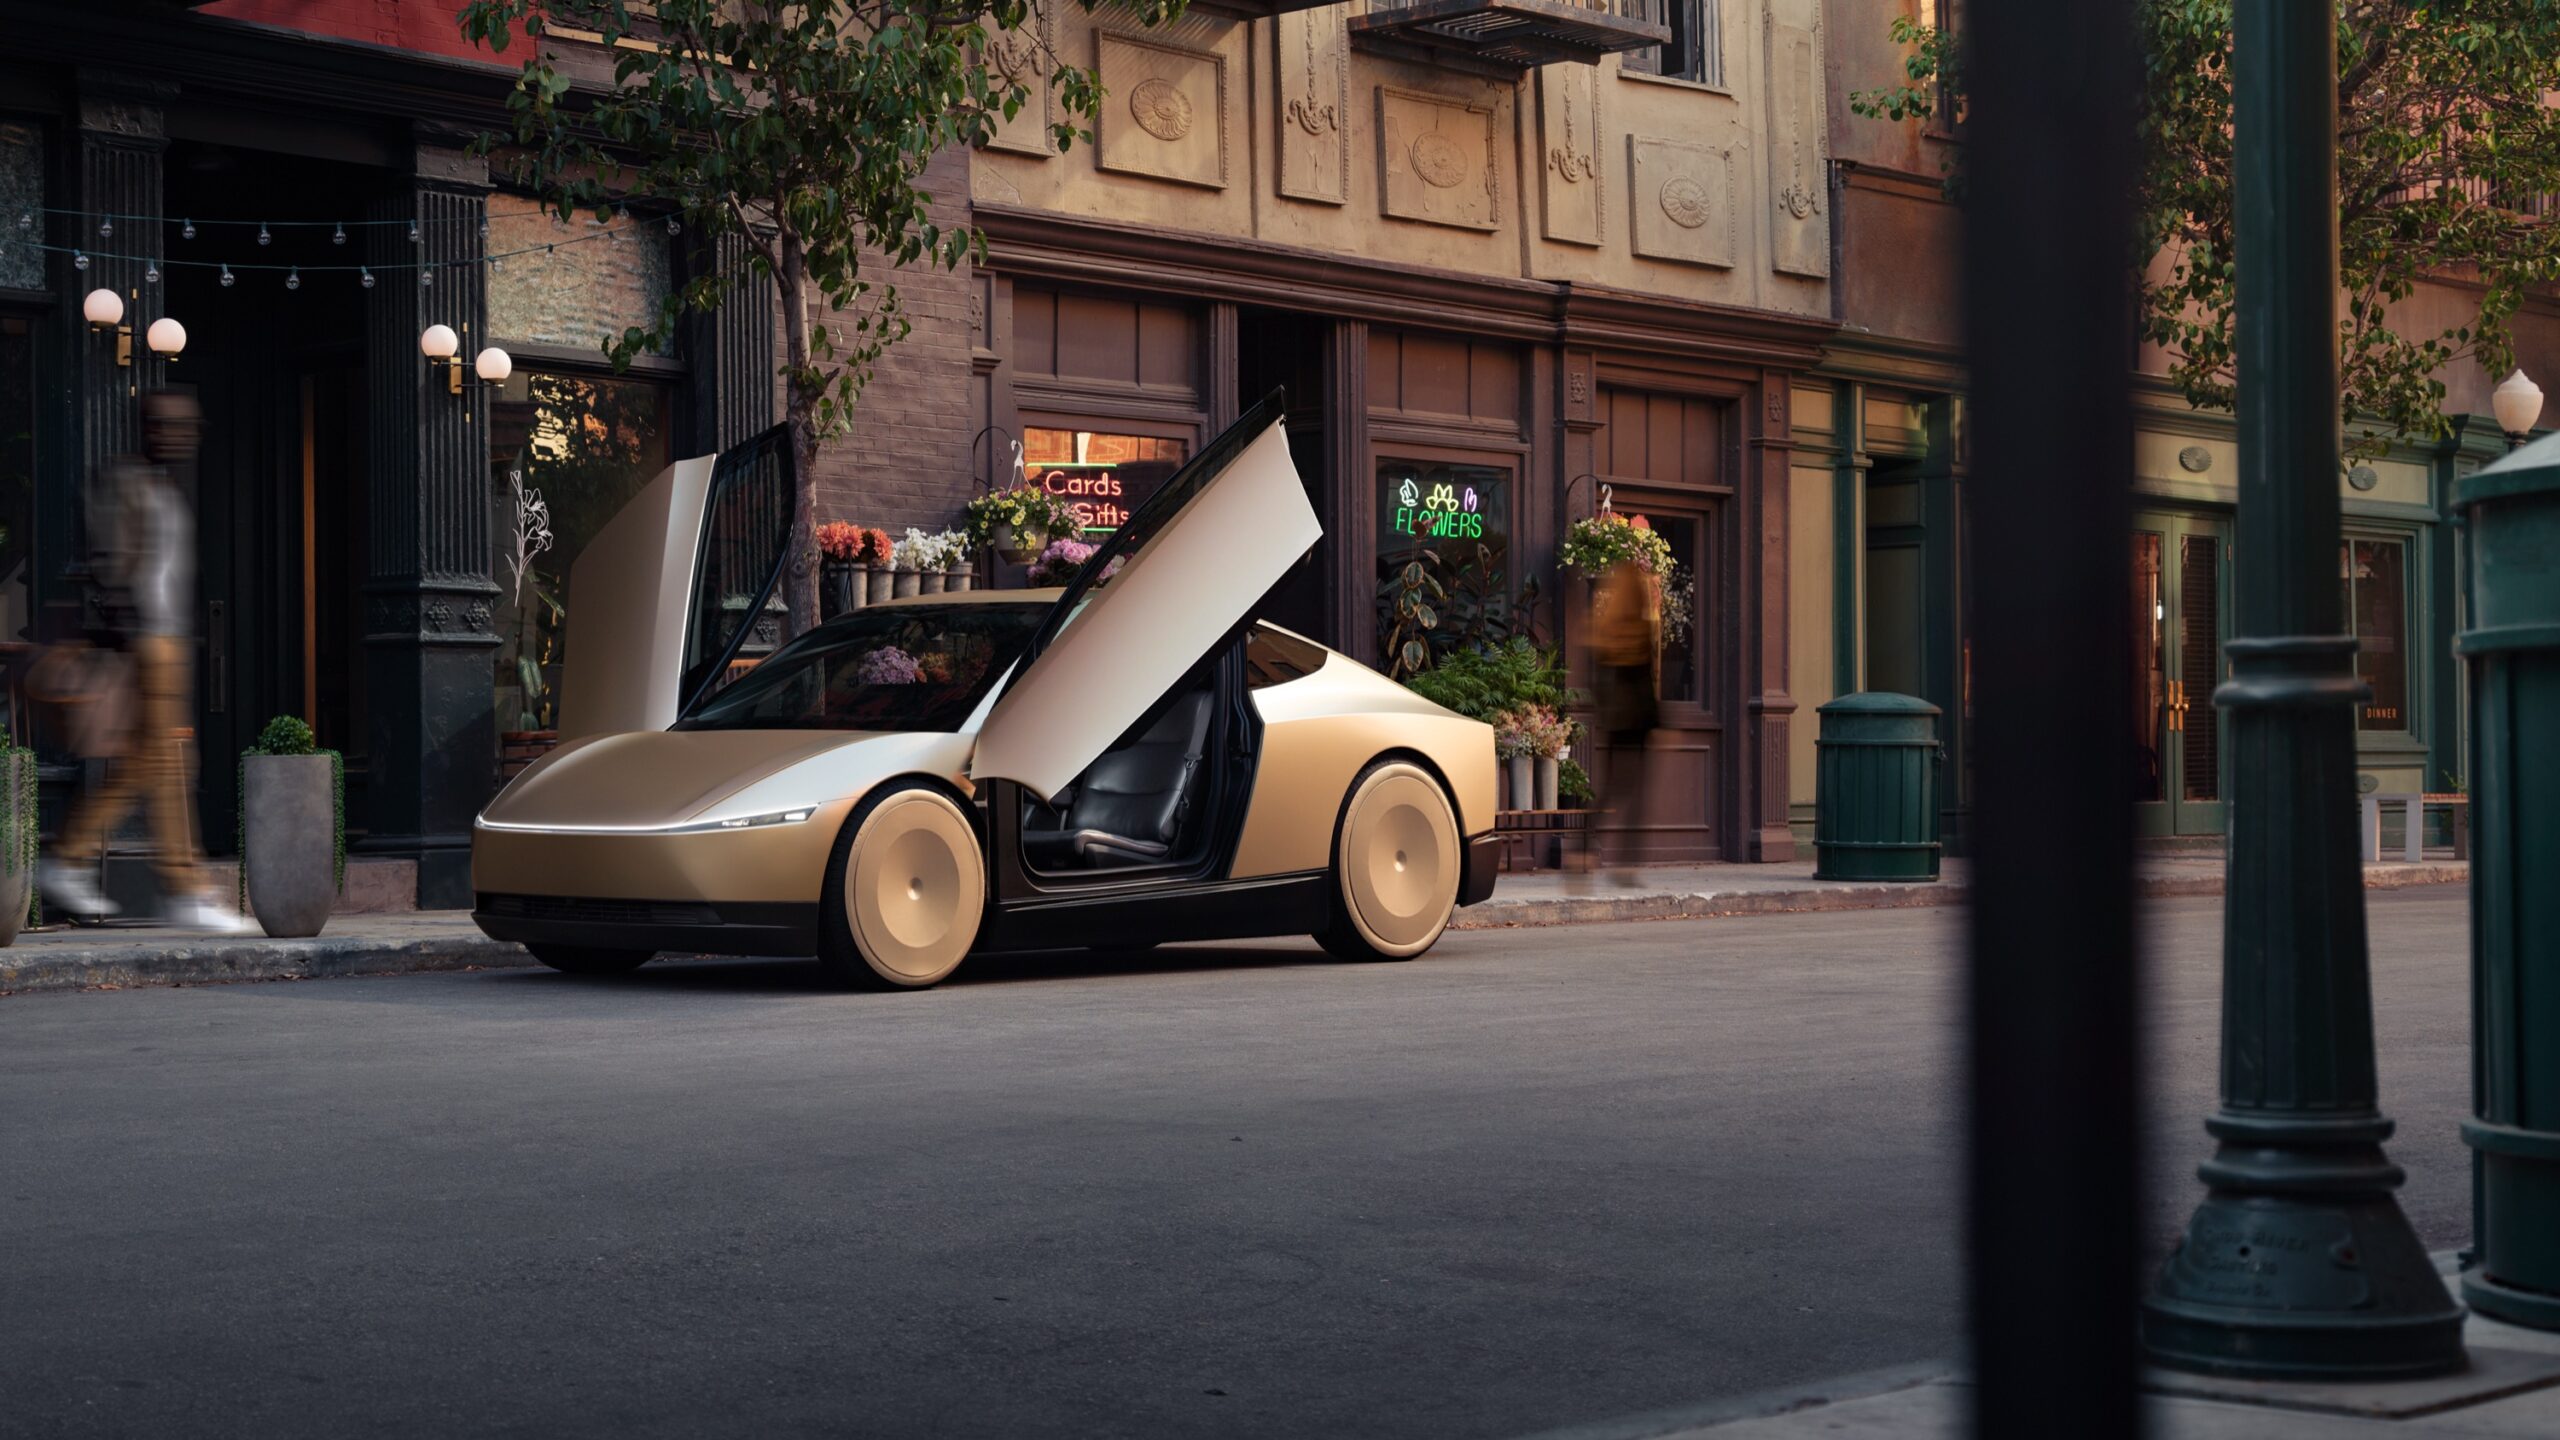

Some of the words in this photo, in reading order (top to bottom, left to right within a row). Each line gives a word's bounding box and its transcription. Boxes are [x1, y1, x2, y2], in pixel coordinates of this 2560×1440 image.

[1046, 470, 1122, 496] Cards
[1074, 502, 1130, 526] Gifts
[2366, 707, 2397, 719] DINNER
